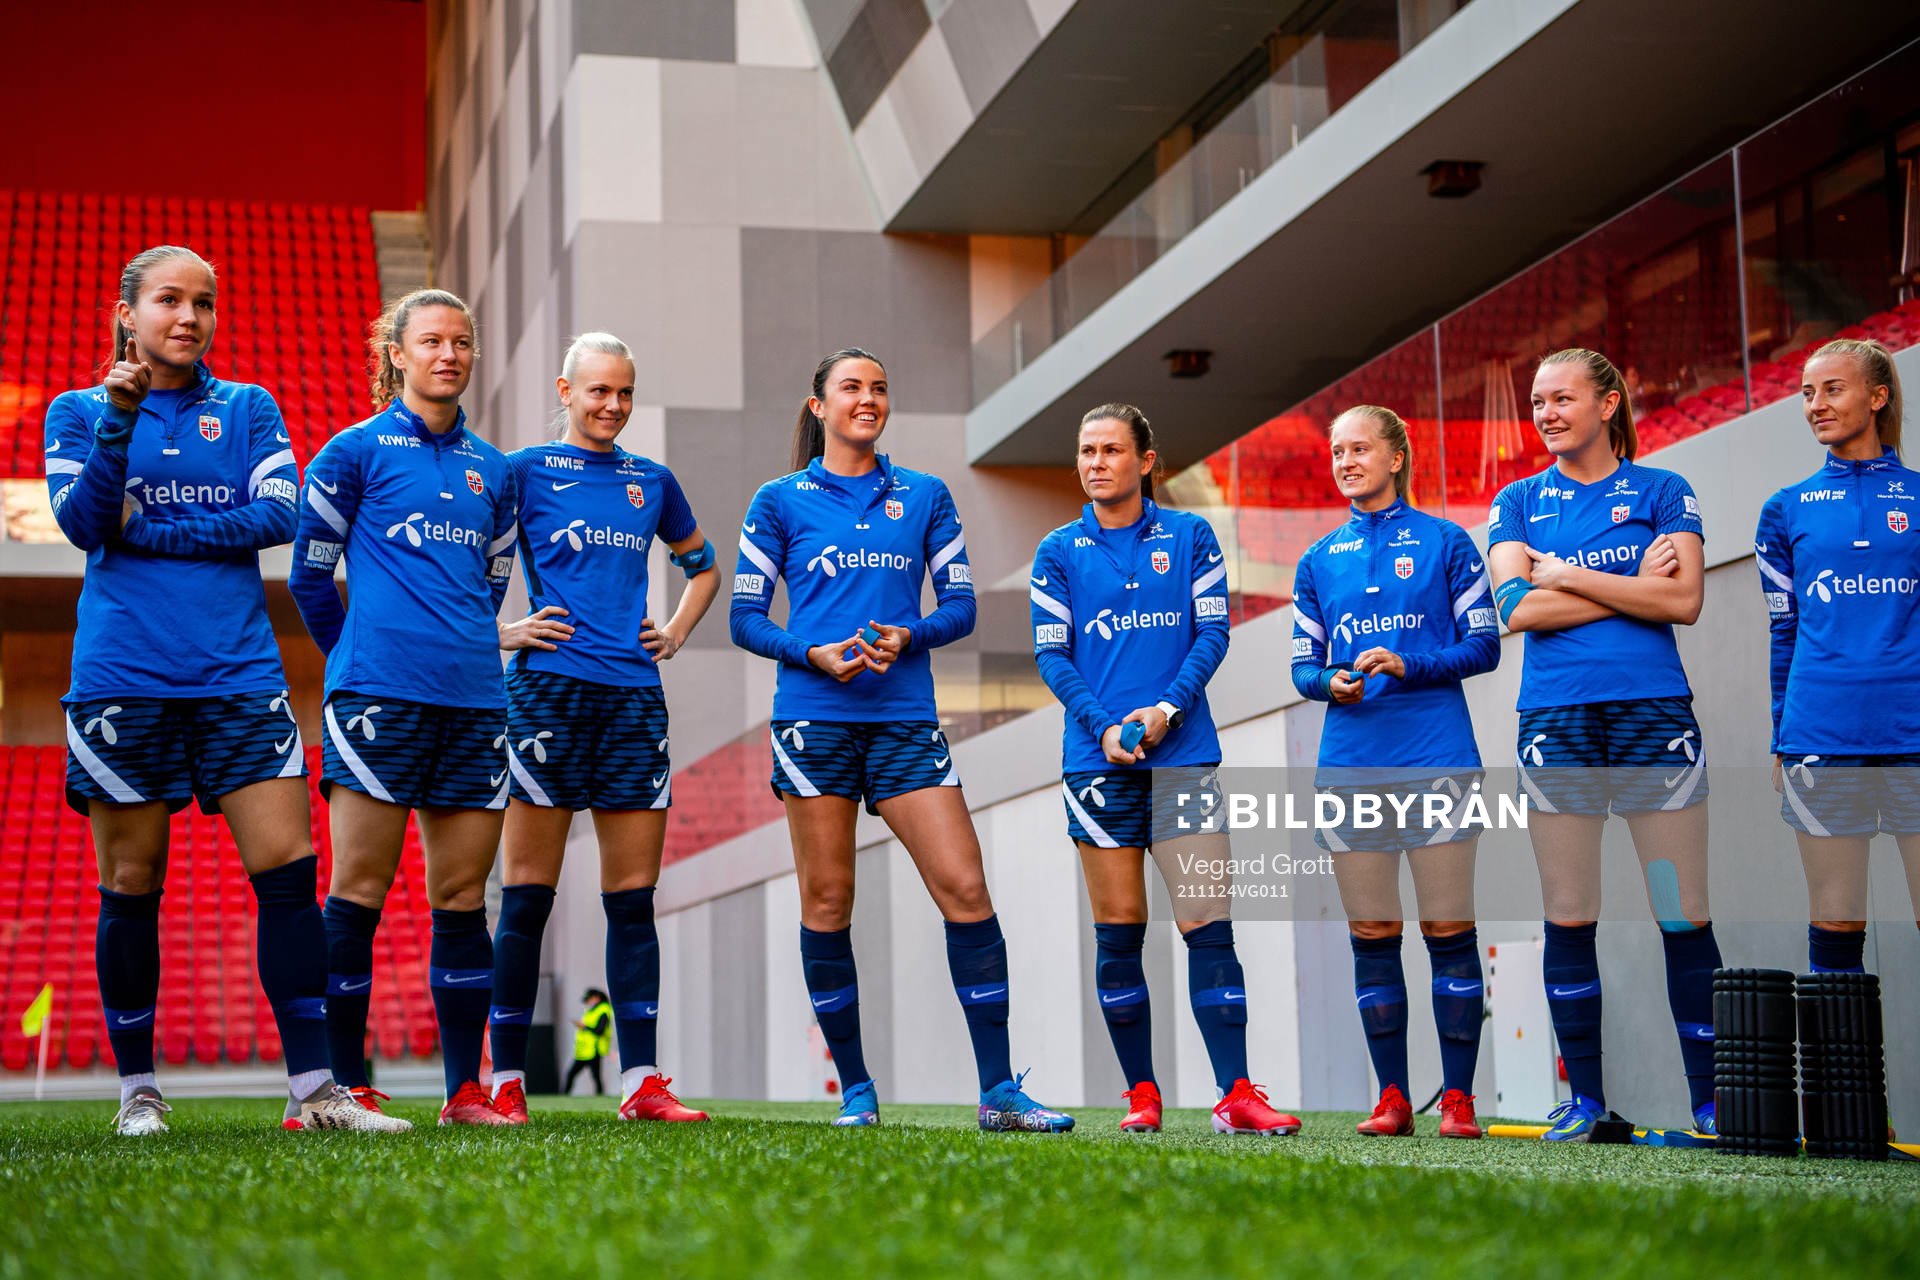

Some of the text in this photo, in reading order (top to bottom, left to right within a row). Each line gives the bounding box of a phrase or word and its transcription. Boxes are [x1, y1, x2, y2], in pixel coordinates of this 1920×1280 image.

[377, 434, 408, 447] KIWI
[545, 455, 572, 470] KIWI
[142, 479, 236, 505] telenor
[261, 478, 294, 497] DNB
[796, 481, 823, 491] KIW
[1800, 489, 1831, 503] KIWI
[422, 520, 488, 550] telenor
[584, 525, 647, 553] telenor
[1328, 541, 1355, 555] KIWI
[1556, 544, 1639, 568] elenor
[837, 547, 912, 572] telenor
[735, 574, 761, 593] DNB
[1832, 573, 1919, 595] telenor
[1200, 597, 1225, 614] DNB
[1111, 609, 1182, 632] telenor
[1352, 613, 1425, 635] telenor
[1473, 608, 1496, 626] DNB
[1038, 624, 1064, 643] DNB
